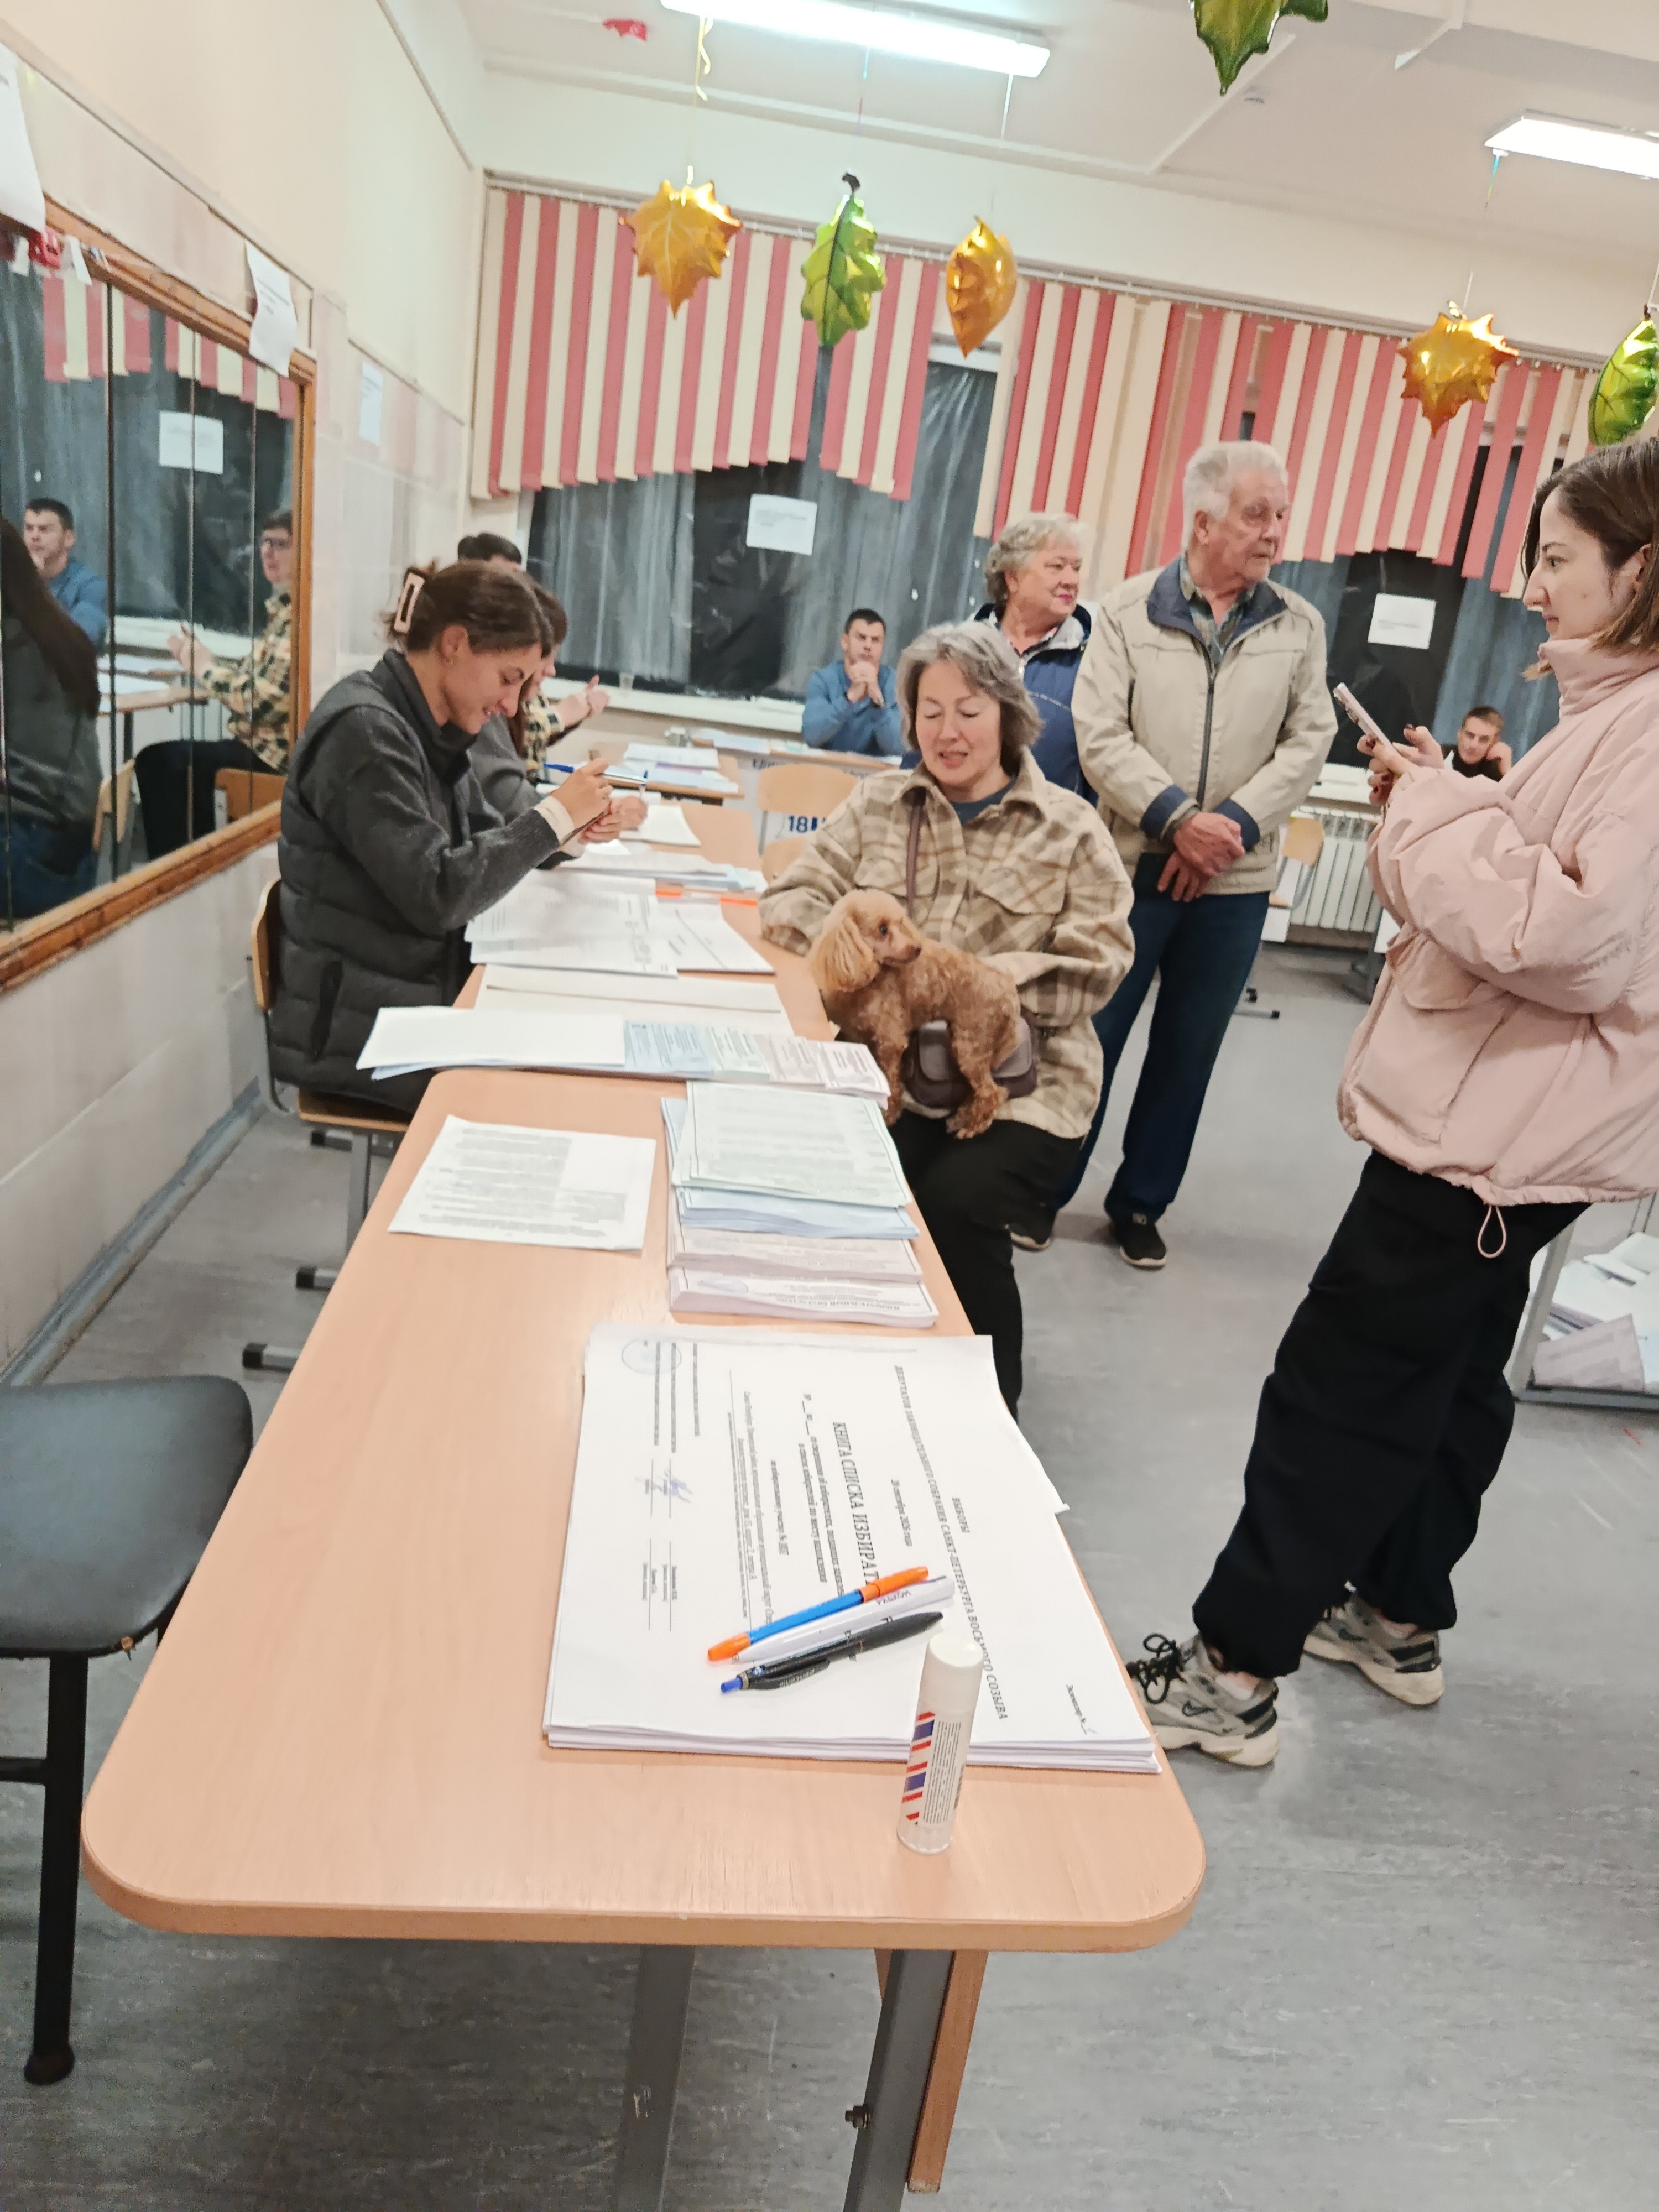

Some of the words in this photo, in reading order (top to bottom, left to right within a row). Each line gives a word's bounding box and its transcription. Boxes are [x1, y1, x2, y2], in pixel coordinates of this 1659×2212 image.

[833, 1422, 852, 1457] КНИГА
[841, 1459, 864, 1509] СПИСКА
[952, 1498, 970, 1532] ВЫБОРЫ
[928, 1480, 947, 1522] СОБРАНИЯ
[941, 1525, 974, 1614] САНКТ-ПЕТЕРБУРГА
[986, 1675, 1008, 1719] СОЗЫВА
